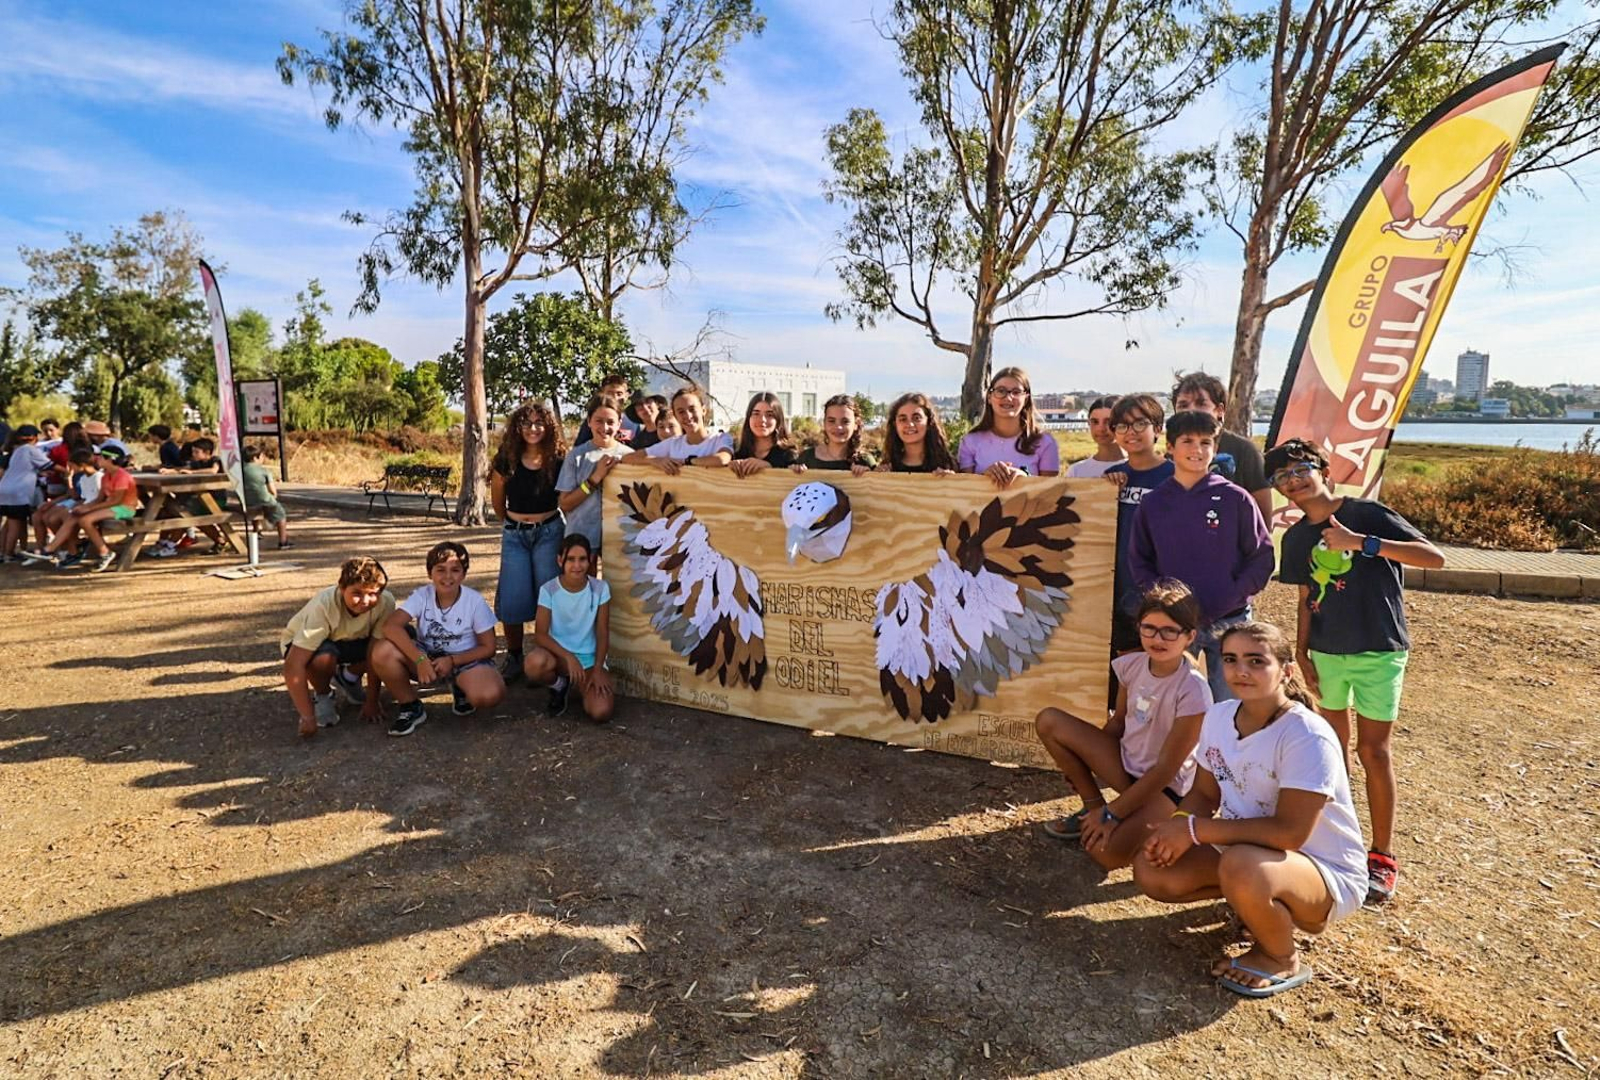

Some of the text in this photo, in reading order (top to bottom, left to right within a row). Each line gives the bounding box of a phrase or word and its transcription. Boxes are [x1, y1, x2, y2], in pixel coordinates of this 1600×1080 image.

[1348, 255, 1388, 329] GRUPO
[1323, 268, 1444, 471] ÁGUILA
[761, 581, 879, 624] MARISMAS
[789, 618, 835, 657] DEL
[775, 655, 850, 696] ODIEL
[977, 714, 1041, 745] ESCUEL
